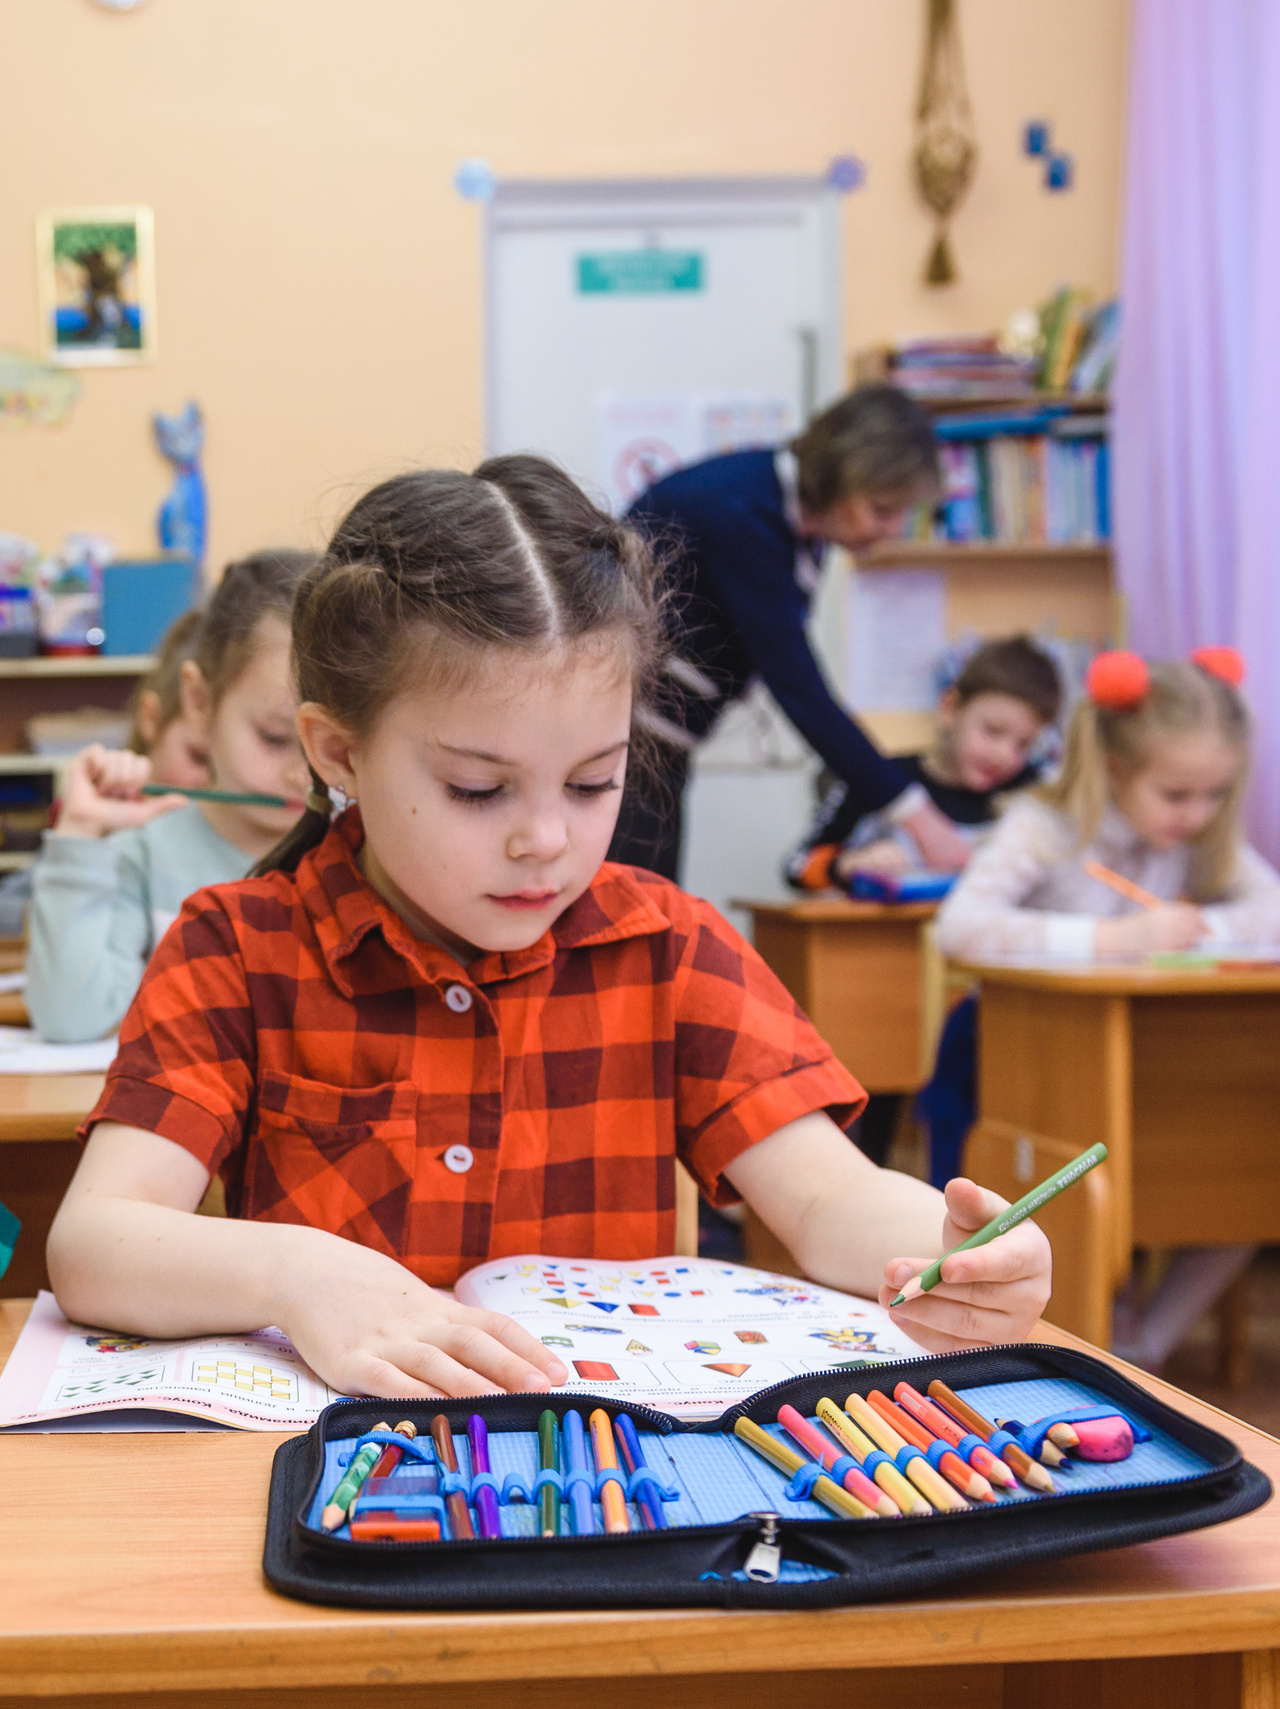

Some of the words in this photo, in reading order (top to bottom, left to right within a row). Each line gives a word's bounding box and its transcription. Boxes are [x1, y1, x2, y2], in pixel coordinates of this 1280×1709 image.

[70, 1397, 145, 1411] Цилиндр
[157, 1397, 212, 1408] Конус.
[223, 1407, 315, 1424] Пирамида.
